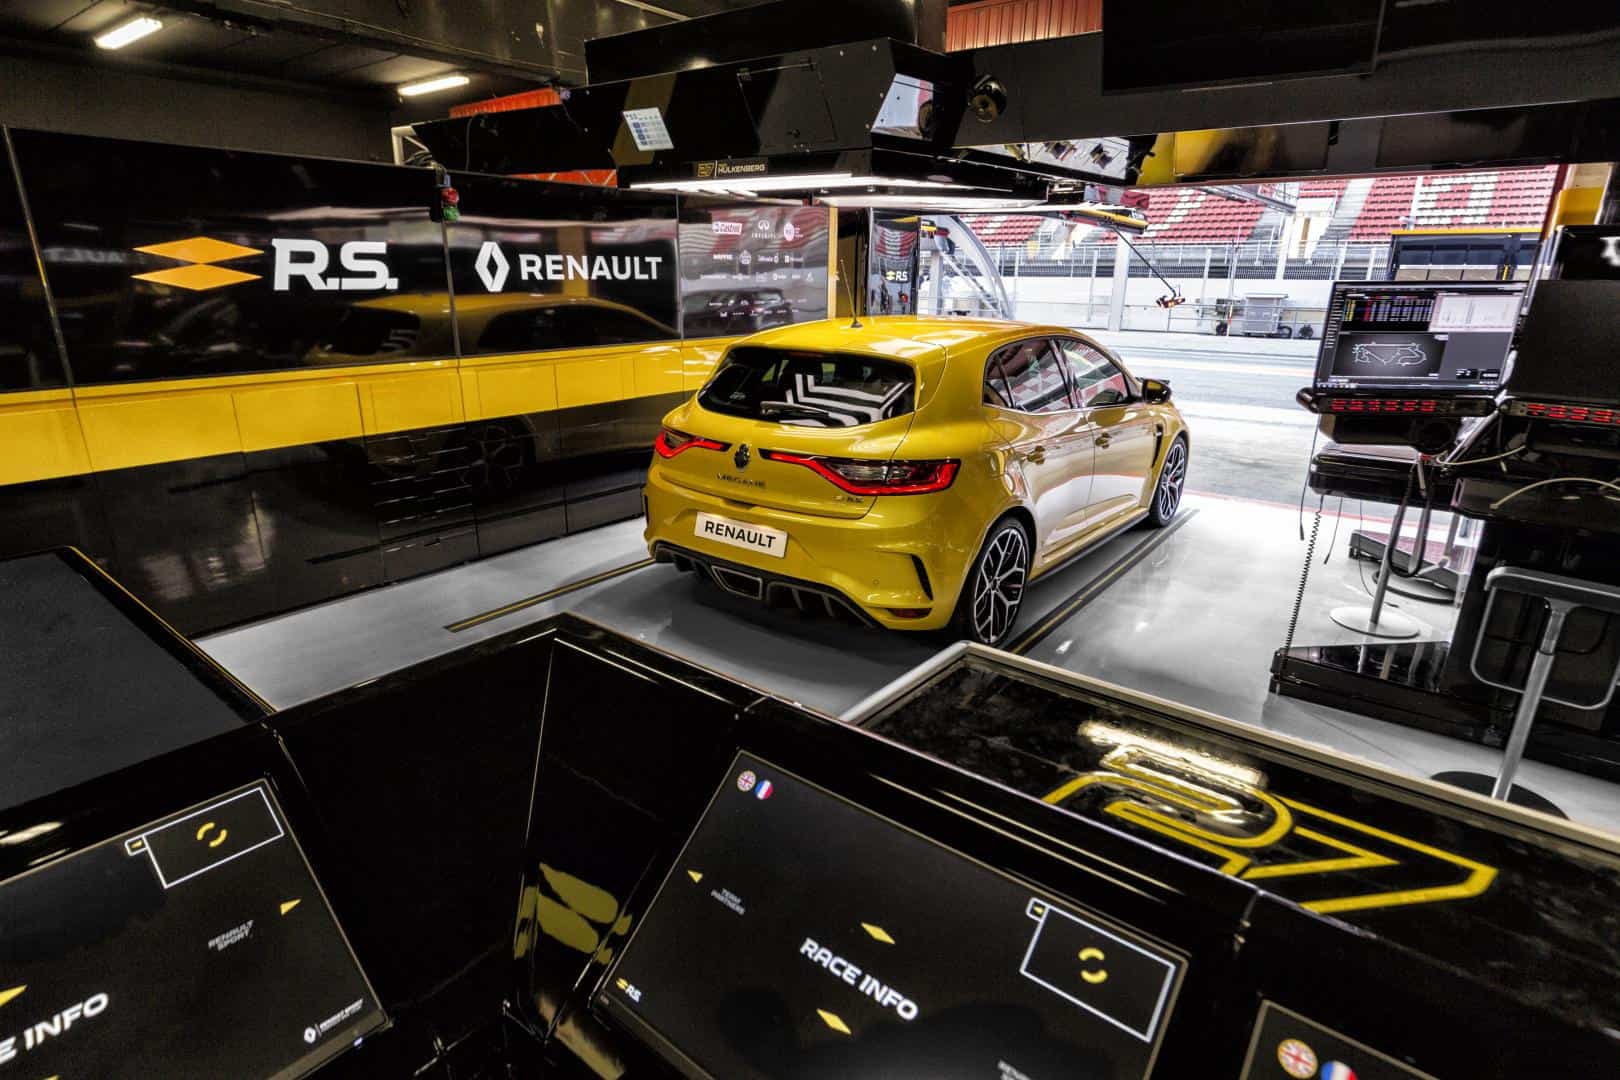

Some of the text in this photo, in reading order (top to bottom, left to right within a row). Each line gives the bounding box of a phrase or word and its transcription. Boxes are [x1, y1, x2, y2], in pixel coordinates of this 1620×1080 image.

[271, 238, 399, 291] R.S.
[518, 253, 662, 281] RENAULT
[704, 521, 776, 548] RENAULT
[800, 937, 919, 1020] RACE INFO
[23, 992, 109, 1051] INFO
